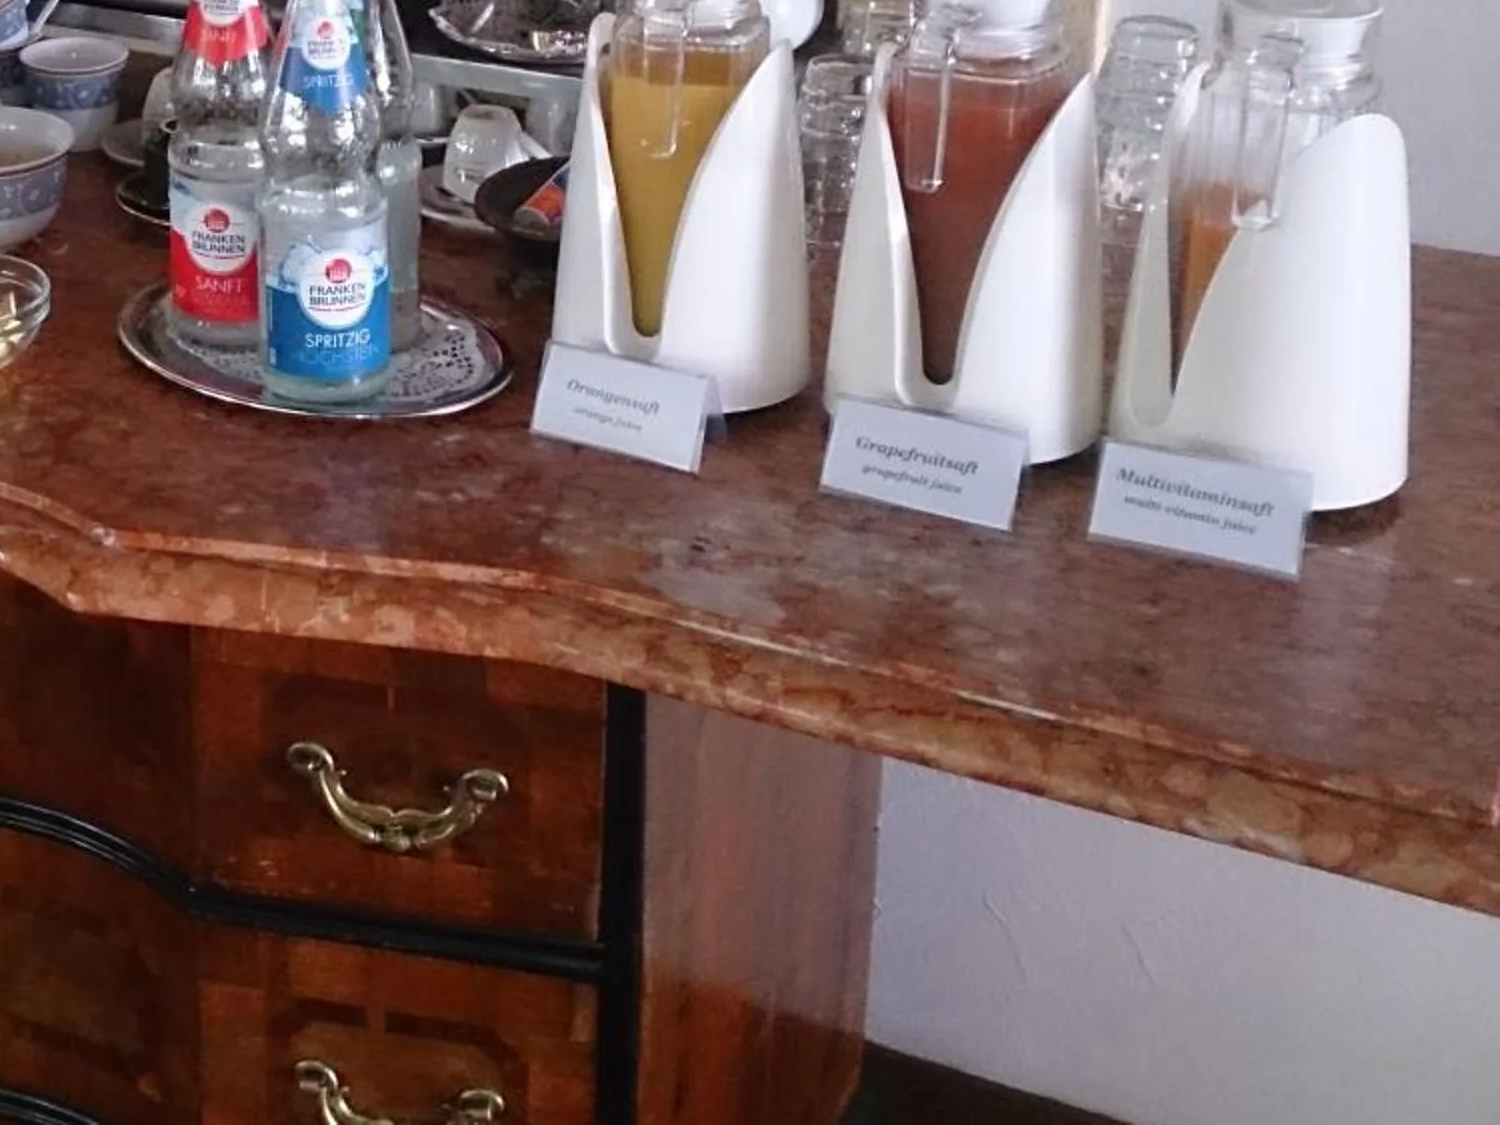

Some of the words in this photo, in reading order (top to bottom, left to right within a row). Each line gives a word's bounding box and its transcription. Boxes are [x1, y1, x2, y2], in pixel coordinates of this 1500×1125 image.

[191, 231, 245, 244] FRANKEN
[191, 242, 245, 253] BRUNNEN
[195, 275, 243, 293] SANFT
[308, 283, 366, 295] FRANKEN
[308, 294, 366, 306] BRUNNEN
[304, 328, 371, 348] SPRITZIG
[855, 435, 979, 476] Grapefruitsaft
[861, 463, 929, 487] grapefruit
[1117, 467, 1276, 518] Multivitaminsaft
